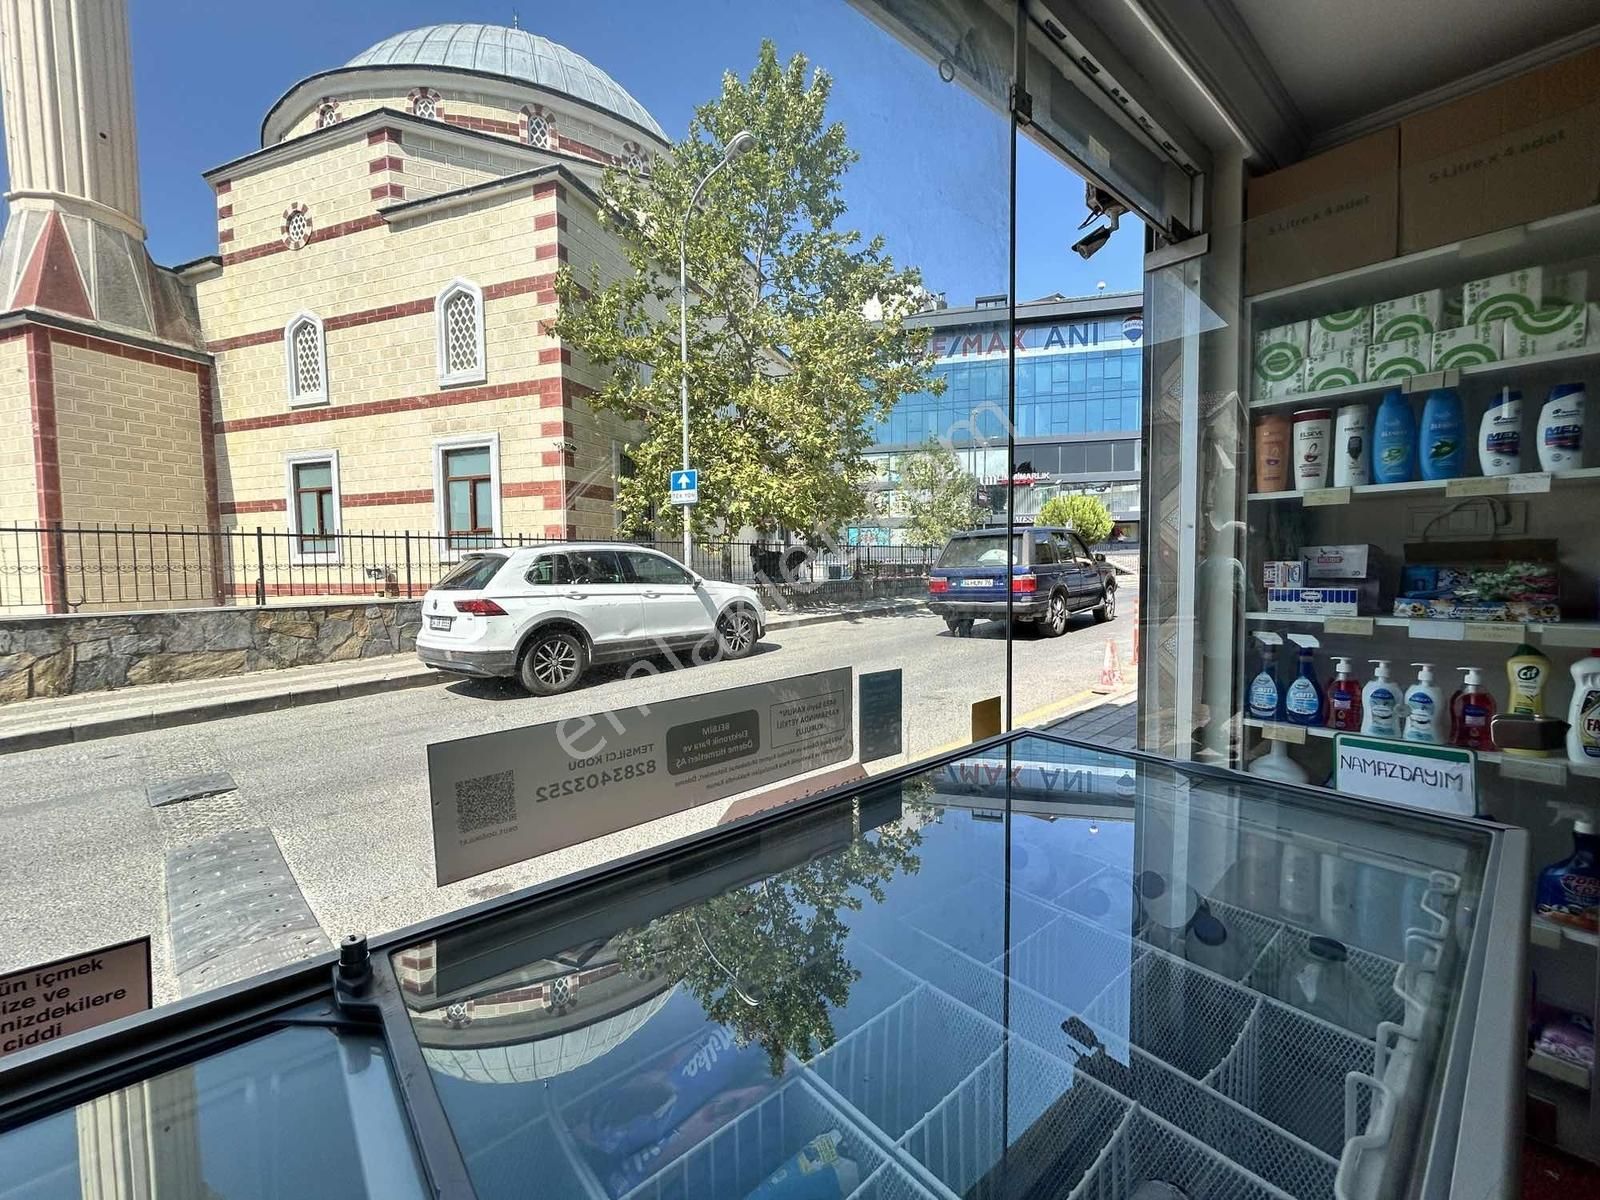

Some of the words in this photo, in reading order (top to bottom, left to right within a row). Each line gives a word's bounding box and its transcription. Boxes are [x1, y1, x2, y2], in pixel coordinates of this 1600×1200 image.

[1442, 158, 1484, 179] Litre
[1520, 129, 1567, 153] adet
[1278, 214, 1310, 231] Litre
[1336, 194, 1371, 213] adet
[931, 326, 1029, 358] E/MAX
[1044, 321, 1099, 350] ANI
[1519, 667, 1538, 679] Cif
[1340, 754, 1465, 792] NAMAZDAYIM
[0, 980, 27, 996] ün
[36, 958, 104, 988] içmek
[0, 988, 127, 1034] nizdekilere
[1, 995, 36, 1016] ize
[43, 986, 70, 1000] ve
[3, 1022, 62, 1052] ciddi
